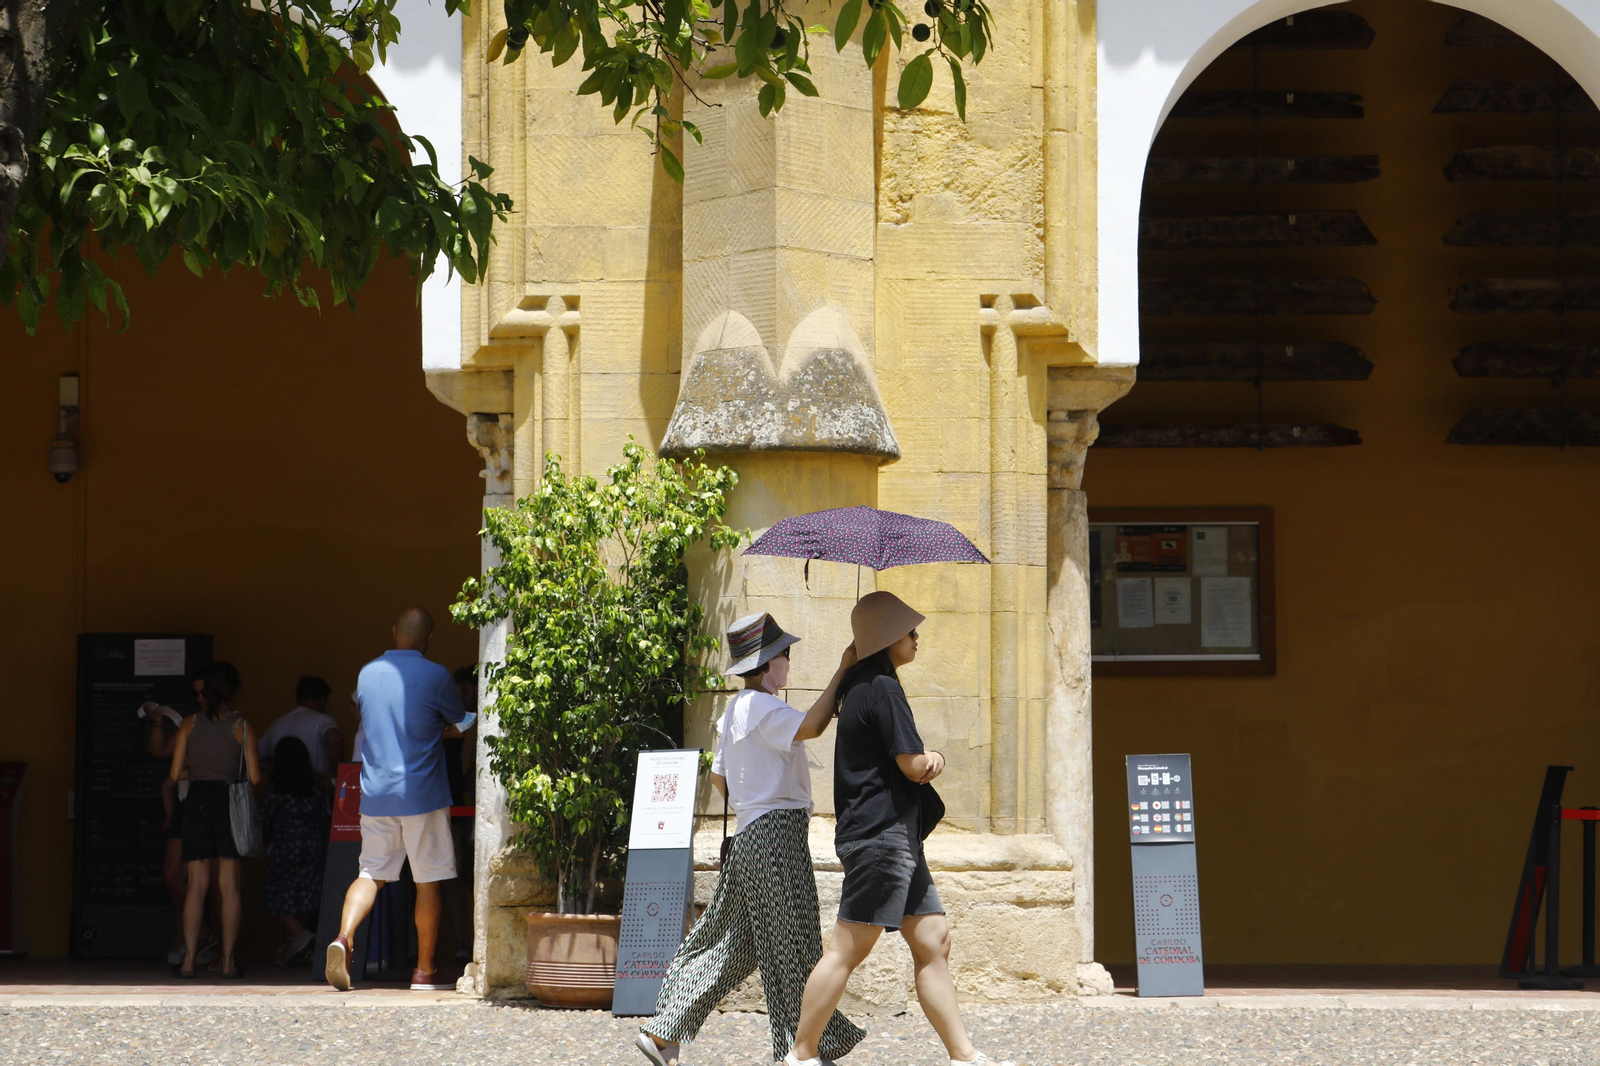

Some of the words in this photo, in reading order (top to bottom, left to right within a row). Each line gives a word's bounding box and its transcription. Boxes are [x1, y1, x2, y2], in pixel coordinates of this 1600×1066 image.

[1151, 938, 1187, 946] CABILDO
[631, 951, 666, 959] CABILDO
[1145, 946, 1194, 955] CATEDRAL
[624, 960, 670, 969] CATEDRAL
[1139, 956, 1151, 965] DE
[617, 970, 628, 979] DE
